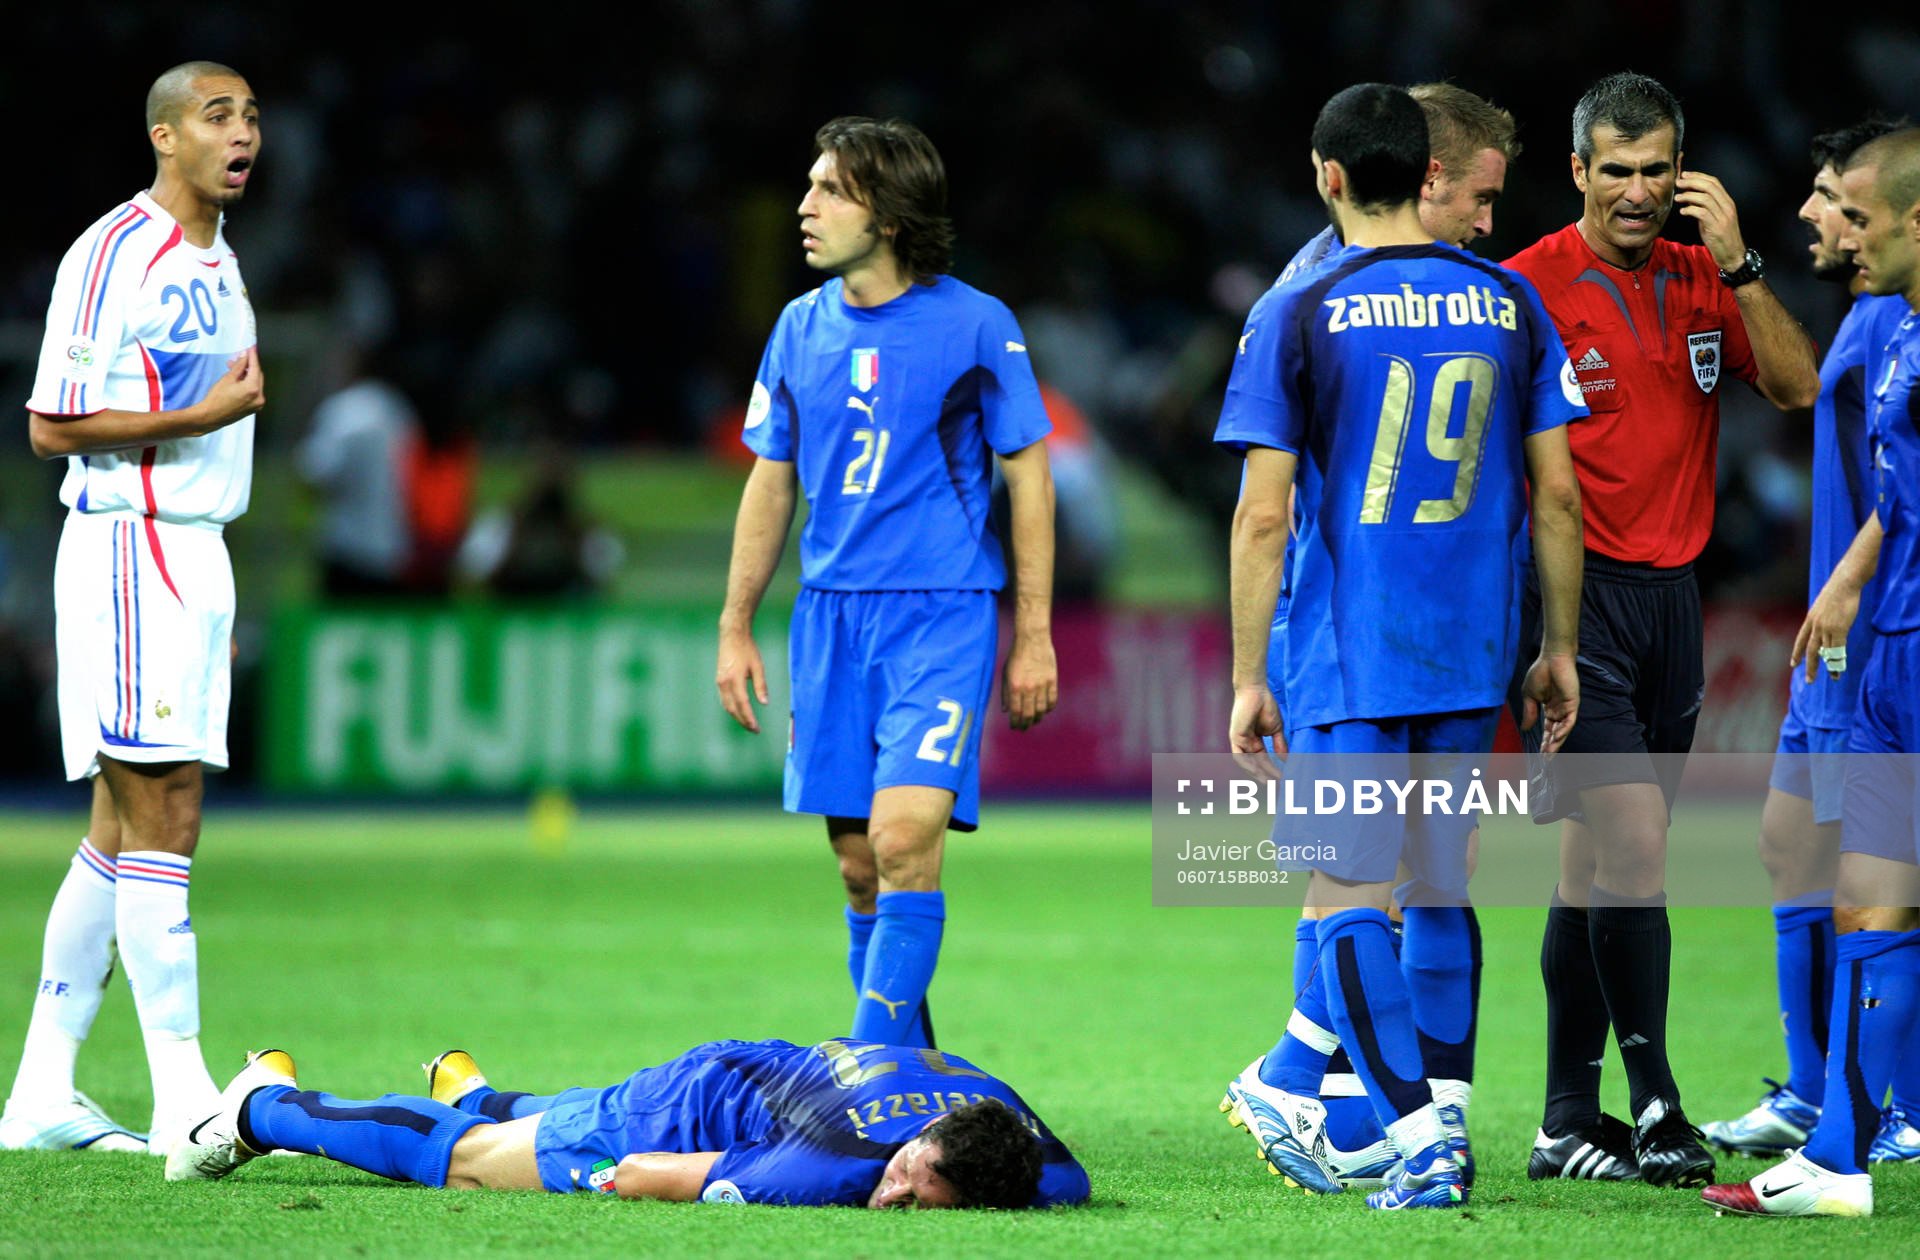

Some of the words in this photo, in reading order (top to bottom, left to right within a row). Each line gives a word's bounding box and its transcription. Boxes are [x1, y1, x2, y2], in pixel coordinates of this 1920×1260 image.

[161, 278, 217, 343] 20
[1324, 284, 1517, 333] zambrotta
[1575, 360, 1609, 371] adidas
[1690, 334, 1720, 347] REFEREE
[1581, 384, 1616, 393] RMANY
[1698, 367, 1716, 380] FIFA
[842, 427, 890, 494] 21
[1359, 352, 1500, 524] 19
[308, 620, 792, 785] FUJIFIL
[916, 696, 975, 767] 21
